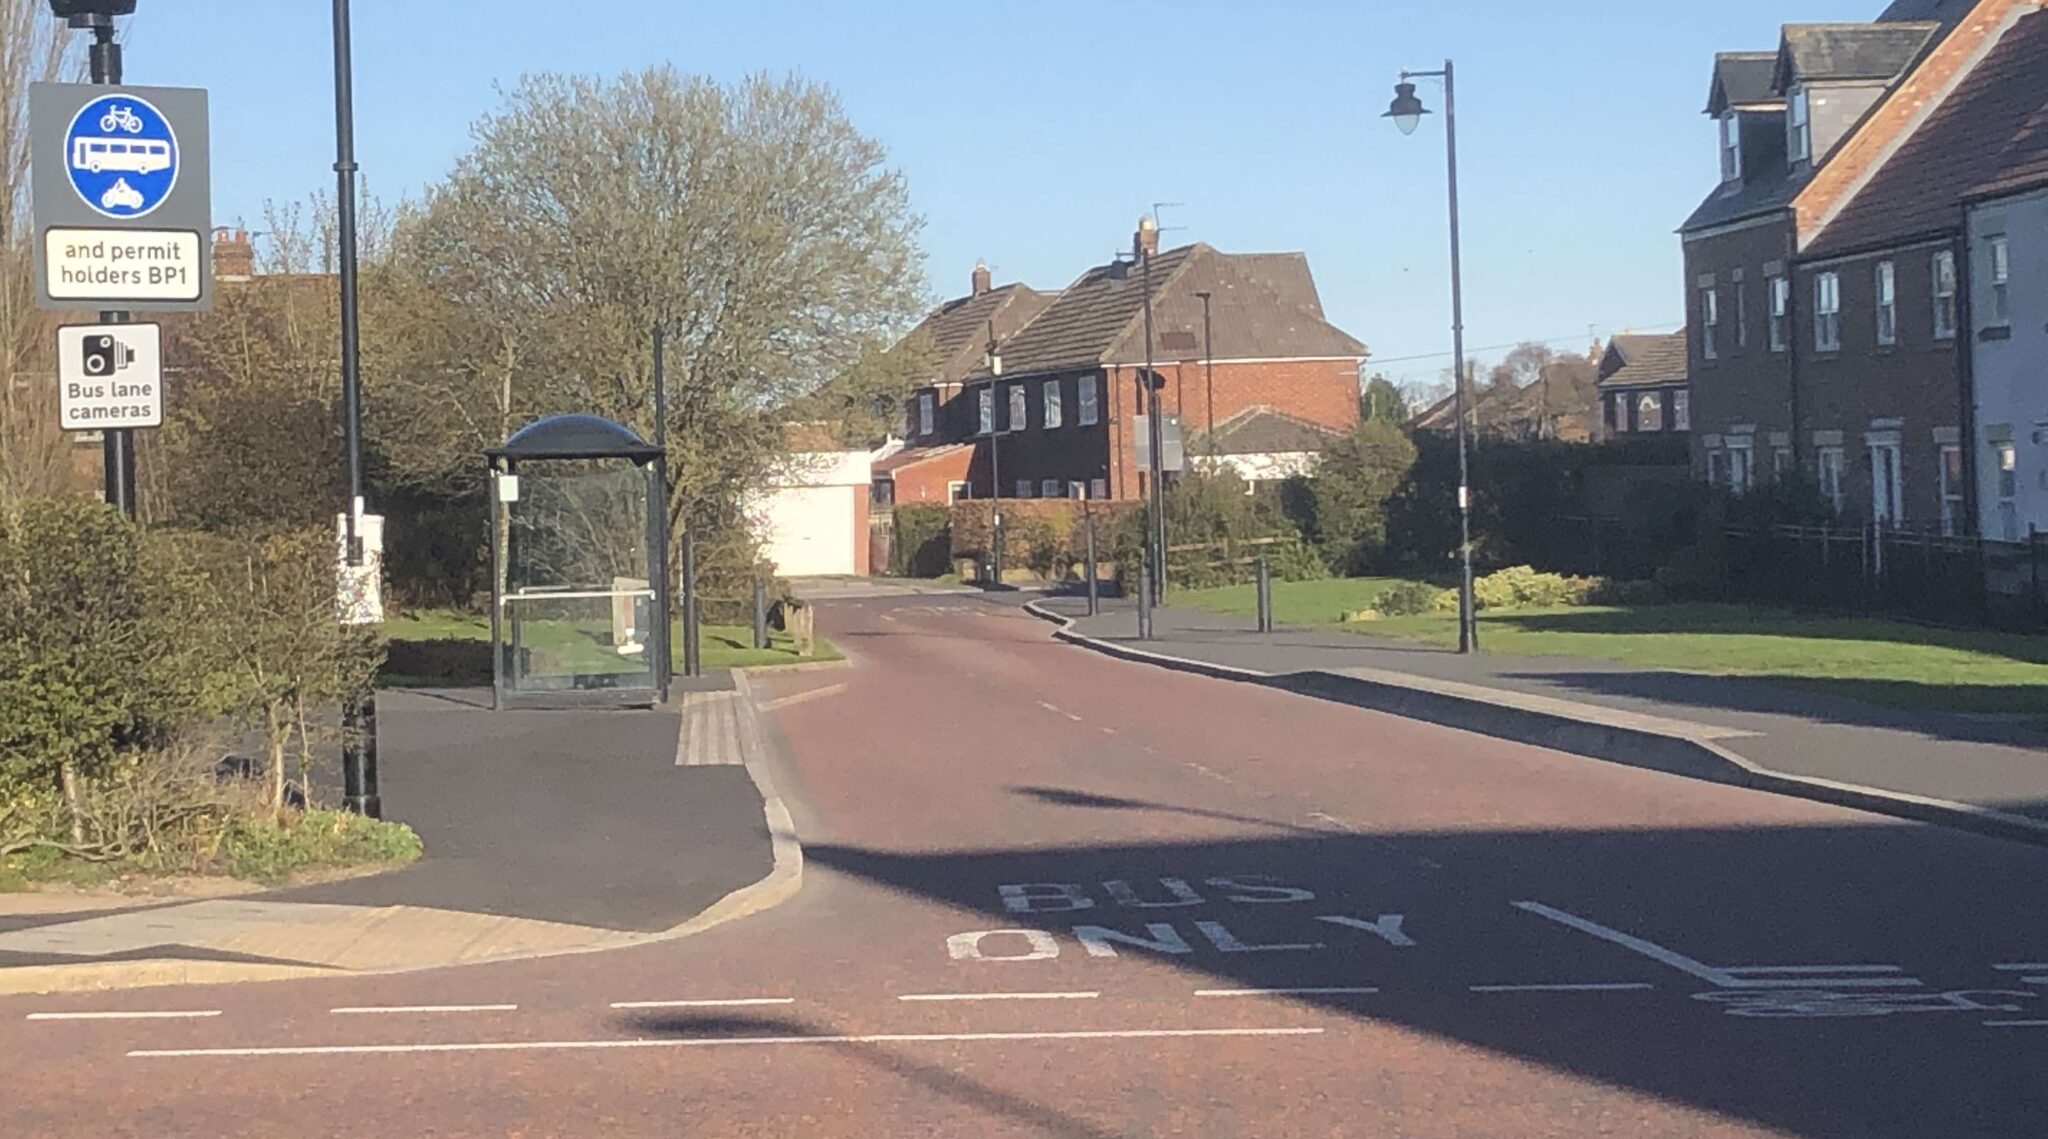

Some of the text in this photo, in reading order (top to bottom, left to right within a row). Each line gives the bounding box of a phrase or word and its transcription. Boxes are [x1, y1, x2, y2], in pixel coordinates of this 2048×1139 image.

[65, 240, 181, 262] and permit
[61, 265, 186, 285] holders BP1
[68, 381, 153, 399] Bus lane
[69, 404, 152, 420] cameras
[997, 875, 1316, 913] BUS
[945, 913, 1417, 961] ONLY
